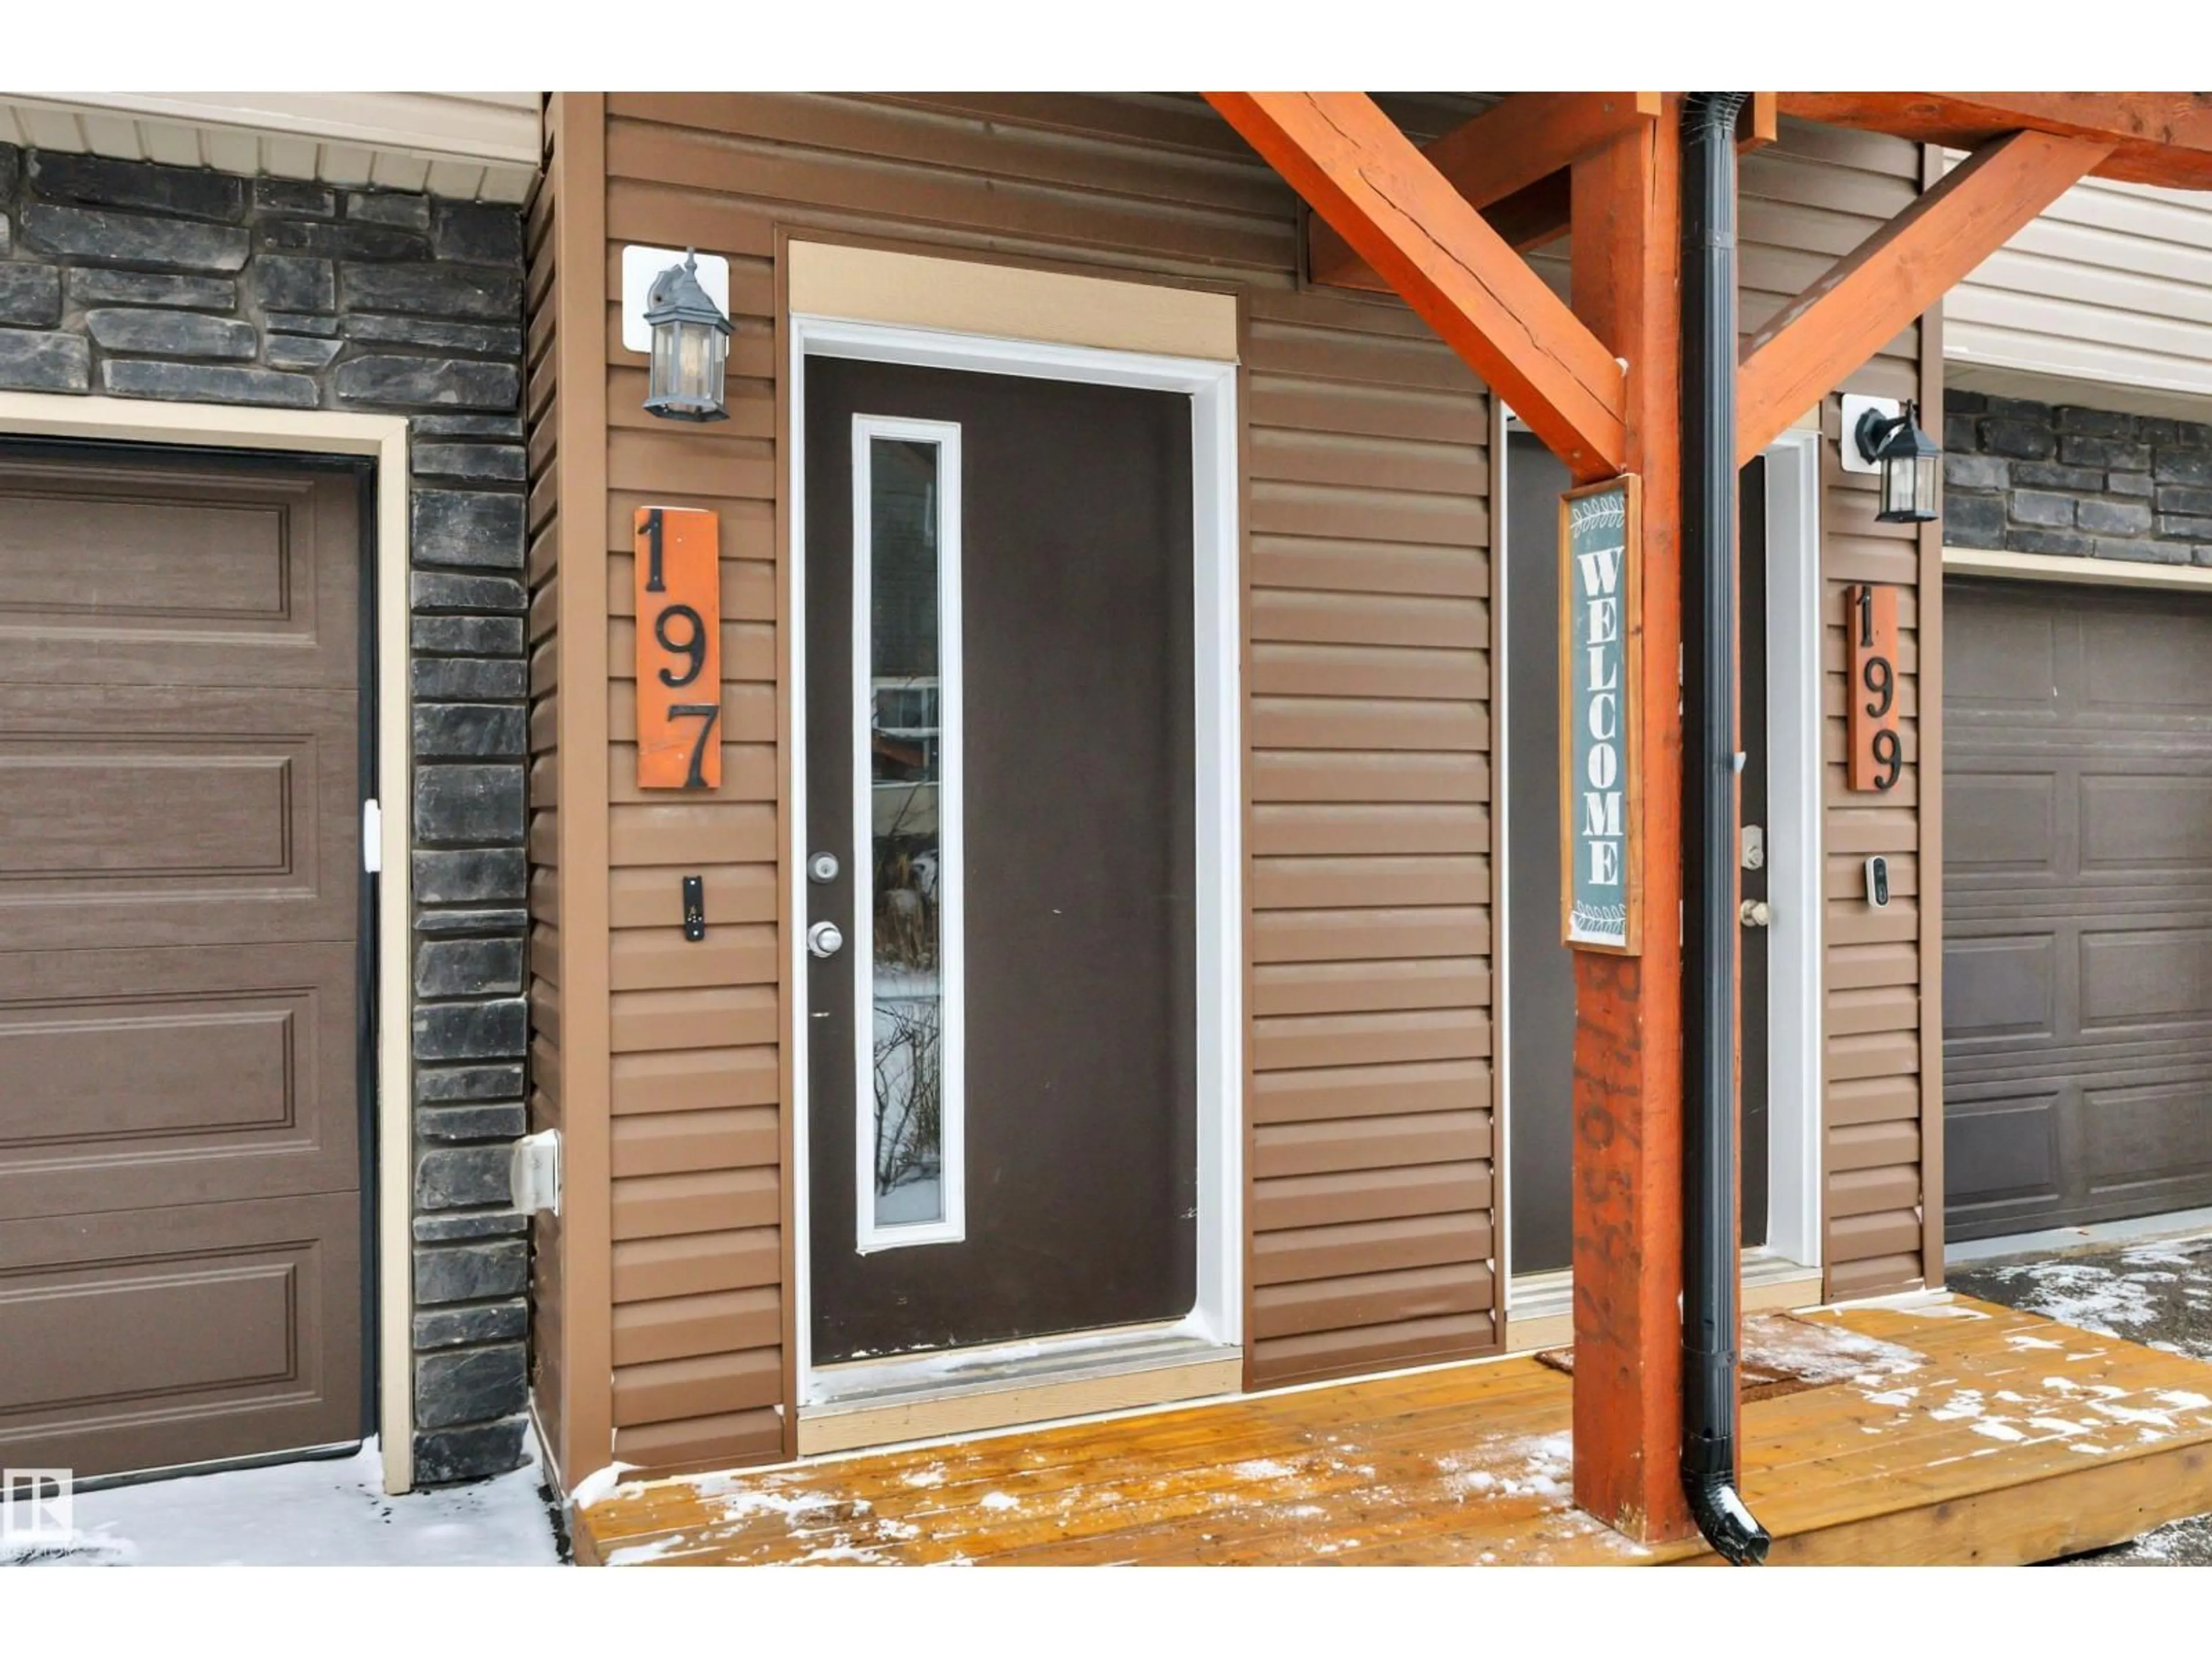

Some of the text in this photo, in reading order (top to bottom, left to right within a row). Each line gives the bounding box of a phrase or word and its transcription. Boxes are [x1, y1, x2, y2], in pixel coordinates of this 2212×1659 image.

[638, 509, 719, 787] 197
[1577, 546, 1624, 887] WELCOME
[1857, 585, 1901, 790] 199
